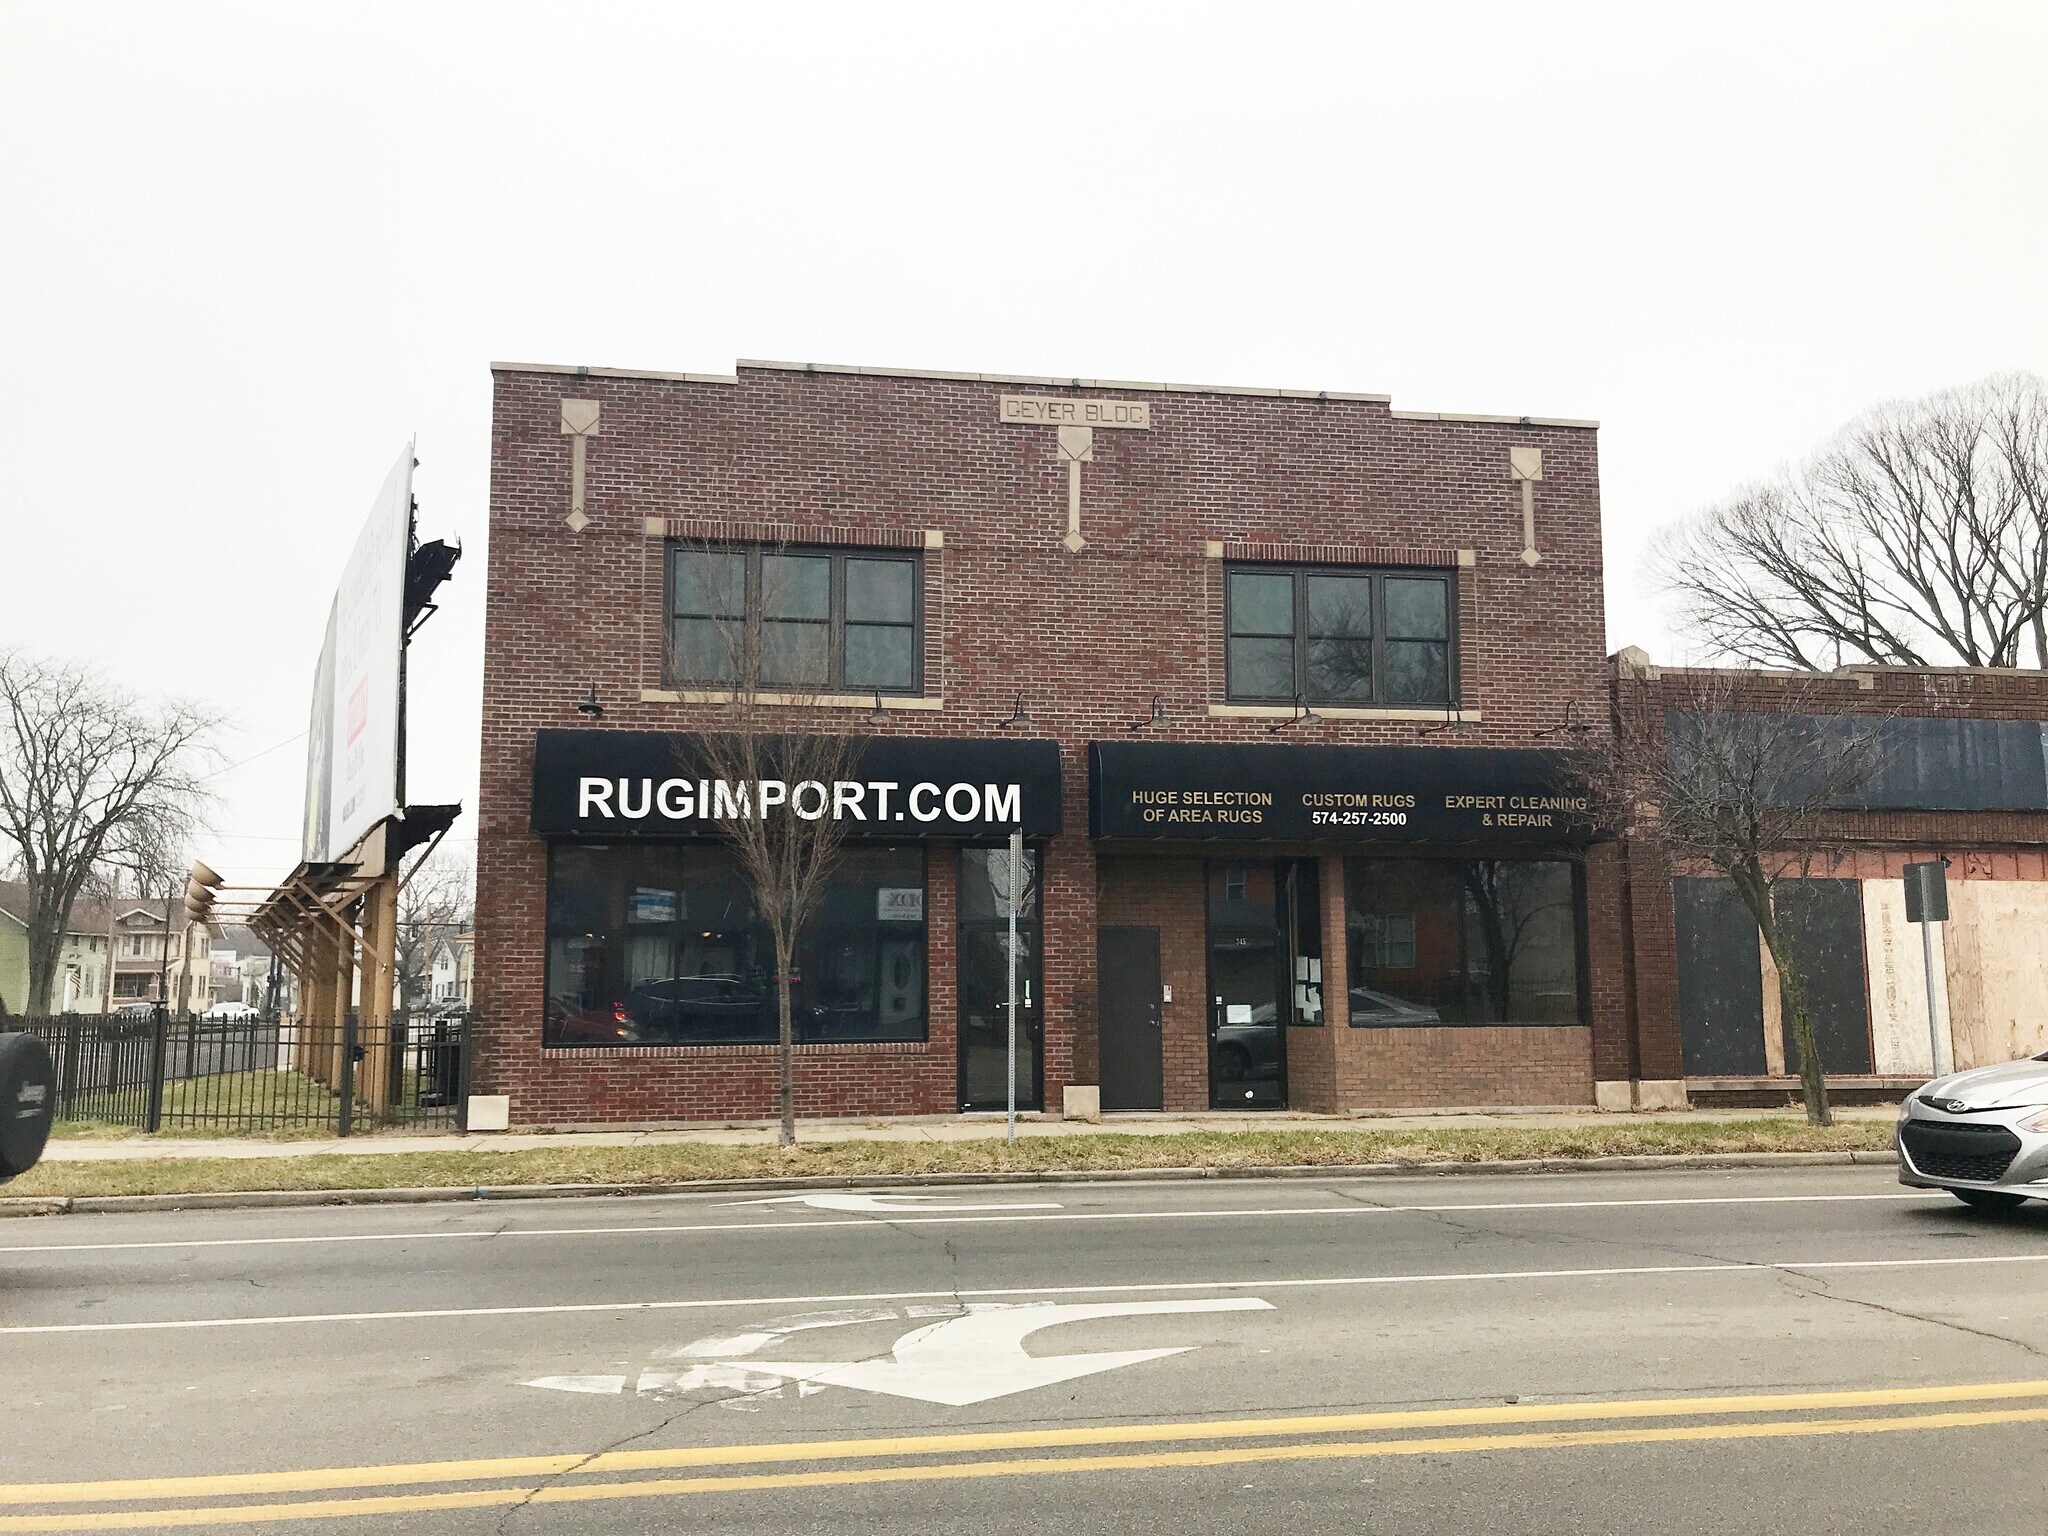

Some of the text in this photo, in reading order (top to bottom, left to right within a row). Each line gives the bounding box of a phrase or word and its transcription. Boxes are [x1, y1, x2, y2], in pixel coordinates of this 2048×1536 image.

[1006, 400, 1075, 420] GEYER
[578, 776, 1021, 823] RUGIMPORT.COM
[1132, 791, 1272, 806] HUGE SELECTION
[1302, 793, 1416, 808] CUSTOM RUGS
[1445, 795, 1588, 810] EXPERT CLEANING
[1143, 808, 1263, 824] OF AREA RUGS
[1312, 811, 1407, 826] 574-257-2500
[1482, 813, 1553, 827] & REPAIR
